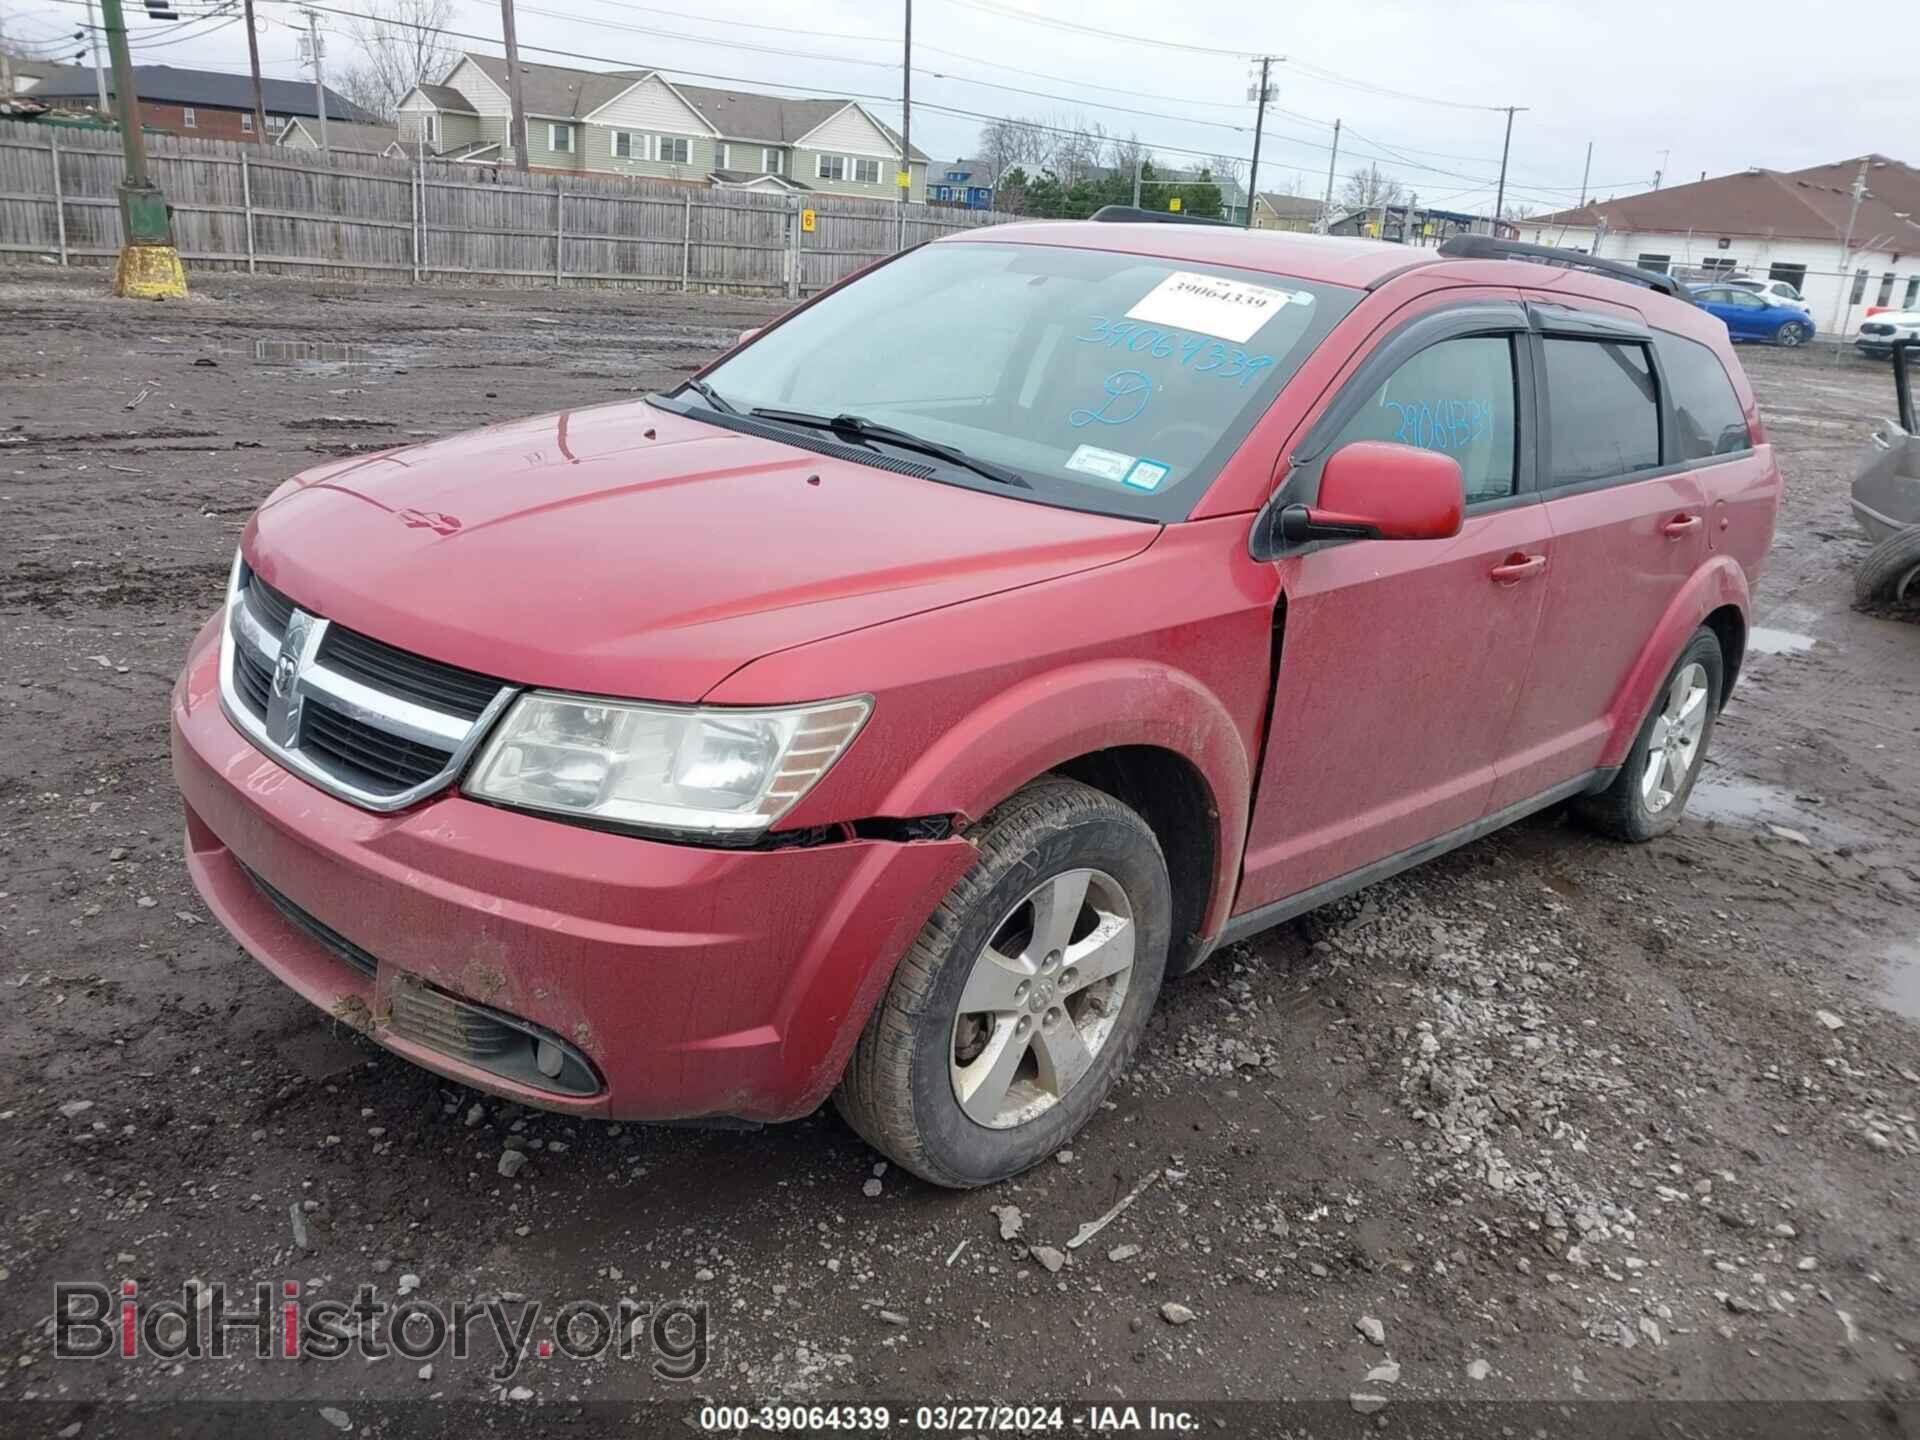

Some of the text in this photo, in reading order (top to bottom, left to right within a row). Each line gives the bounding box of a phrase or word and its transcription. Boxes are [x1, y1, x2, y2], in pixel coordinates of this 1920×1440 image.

[1169, 281, 1268, 308] 39064339
[1074, 315, 1274, 386] 39064339
[1069, 368, 1153, 427] D
